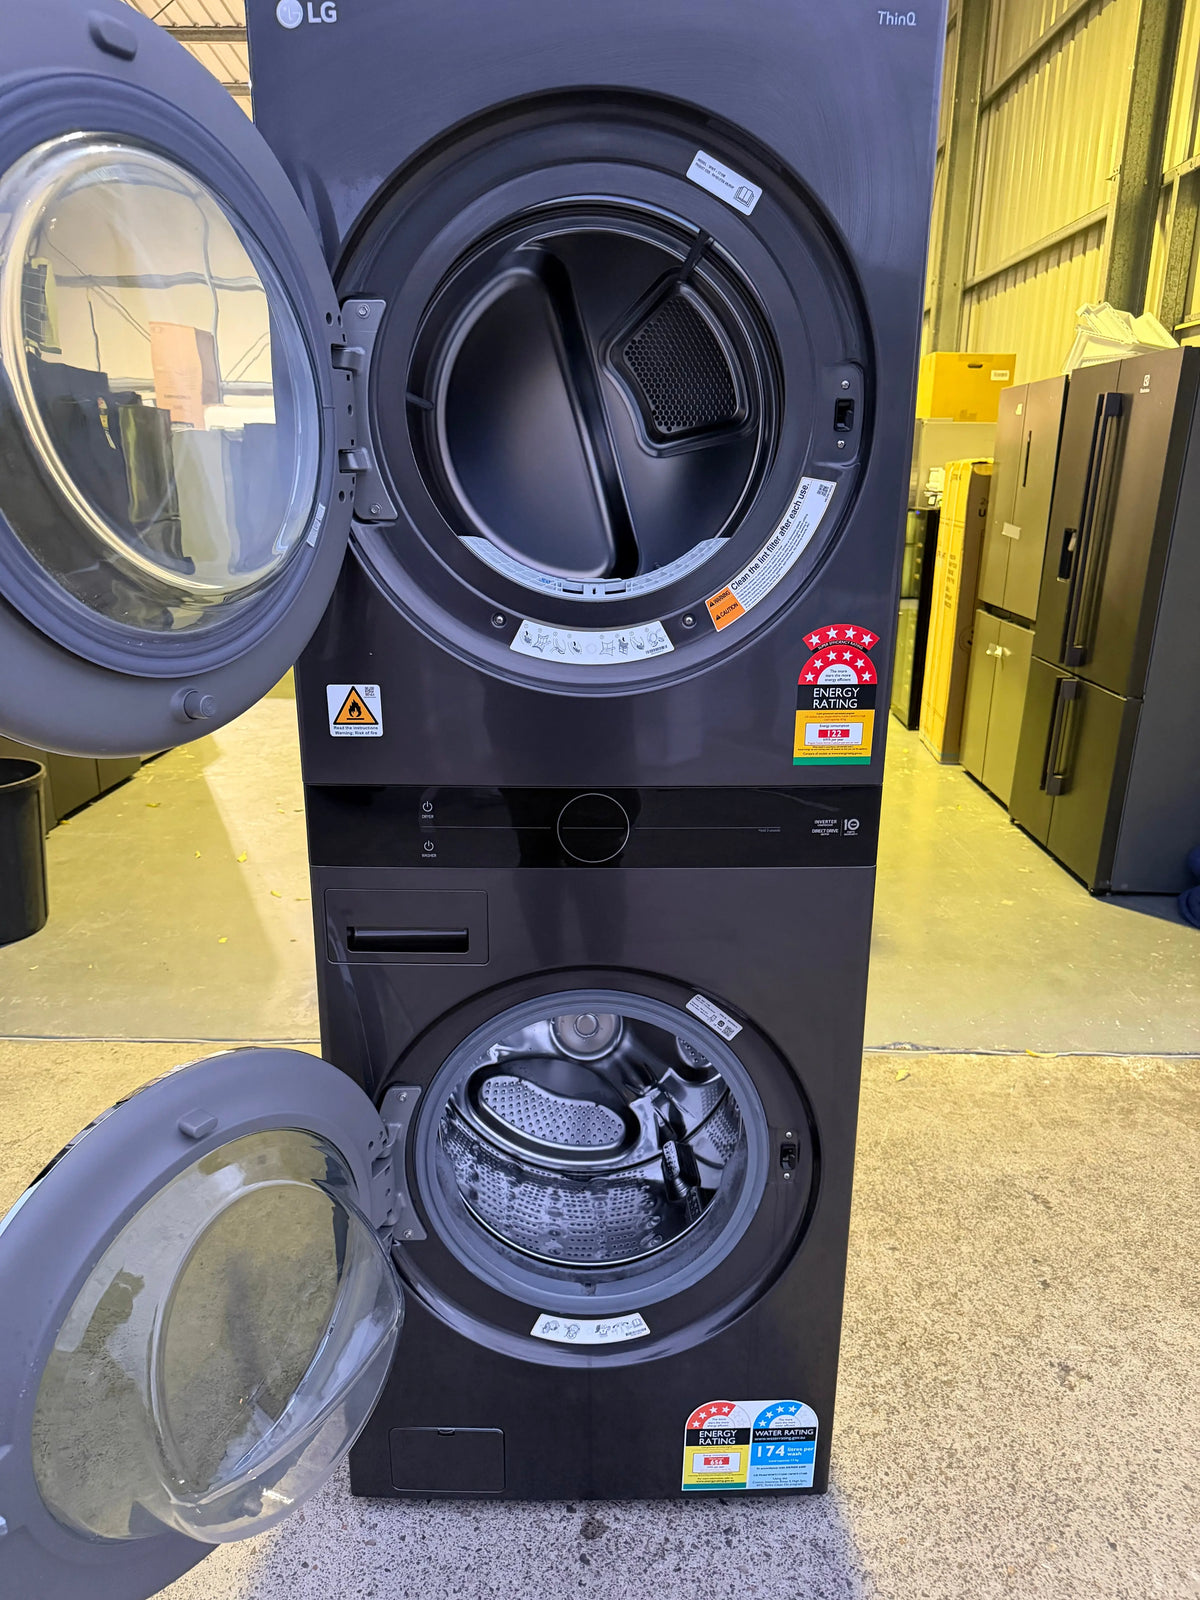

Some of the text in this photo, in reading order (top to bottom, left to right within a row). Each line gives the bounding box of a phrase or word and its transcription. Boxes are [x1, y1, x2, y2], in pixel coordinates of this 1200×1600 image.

[307, 1, 337, 24] LG
[878, 10, 916, 26] ThinQ
[730, 572, 750, 590] Clean
[748, 562, 760, 575] the
[758, 550, 770, 564] lint
[766, 536, 781, 554] filter
[779, 520, 792, 537] after
[790, 500, 802, 519] each
[800, 484, 810, 500] use.
[720, 602, 738, 618] CAUTION
[814, 688, 860, 698] ENERGY
[813, 699, 858, 708] RATING
[758, 1445, 785, 1457] 174
